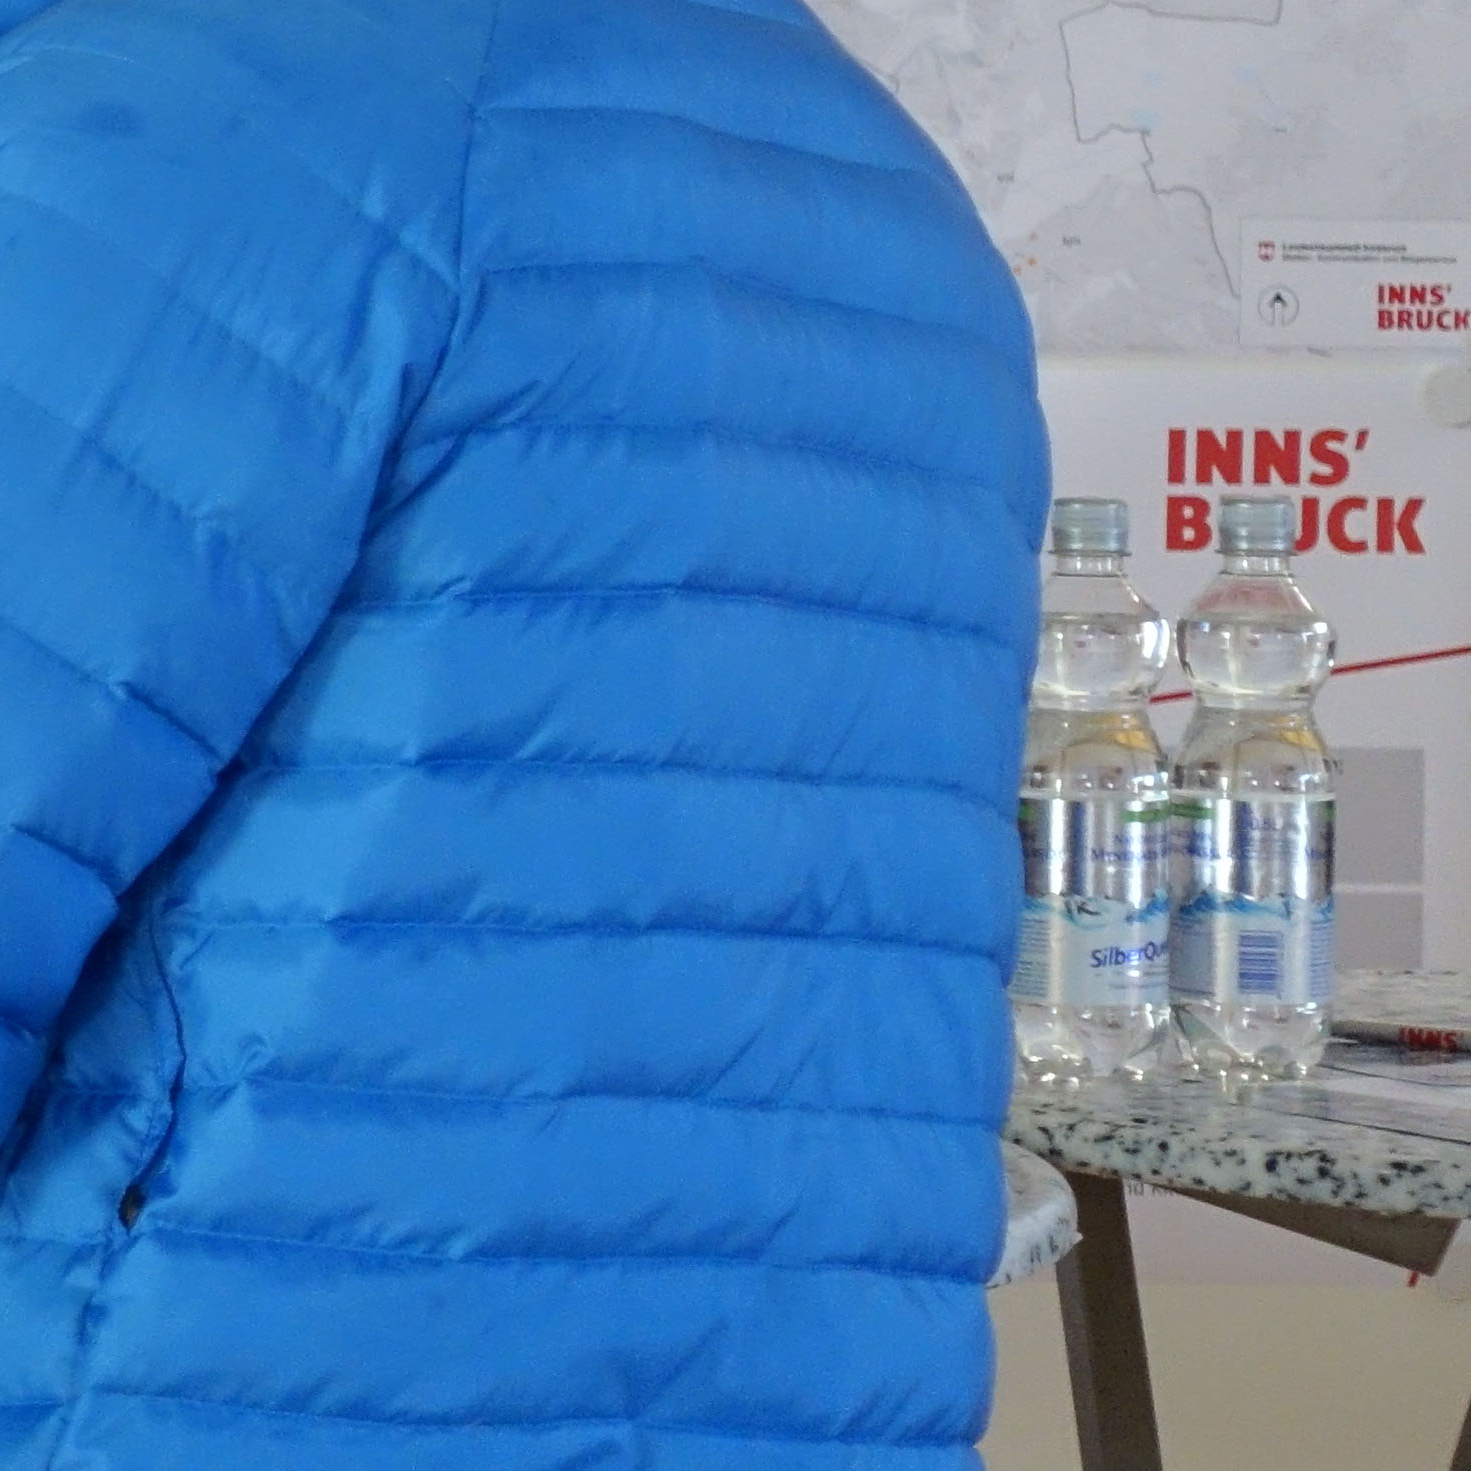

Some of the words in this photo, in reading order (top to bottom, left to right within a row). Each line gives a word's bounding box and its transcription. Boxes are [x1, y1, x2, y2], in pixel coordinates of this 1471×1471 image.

[1377, 283, 1452, 306] INNS'
[1377, 308, 1470, 332] BRUCK
[1166, 428, 1370, 487] INNS'
